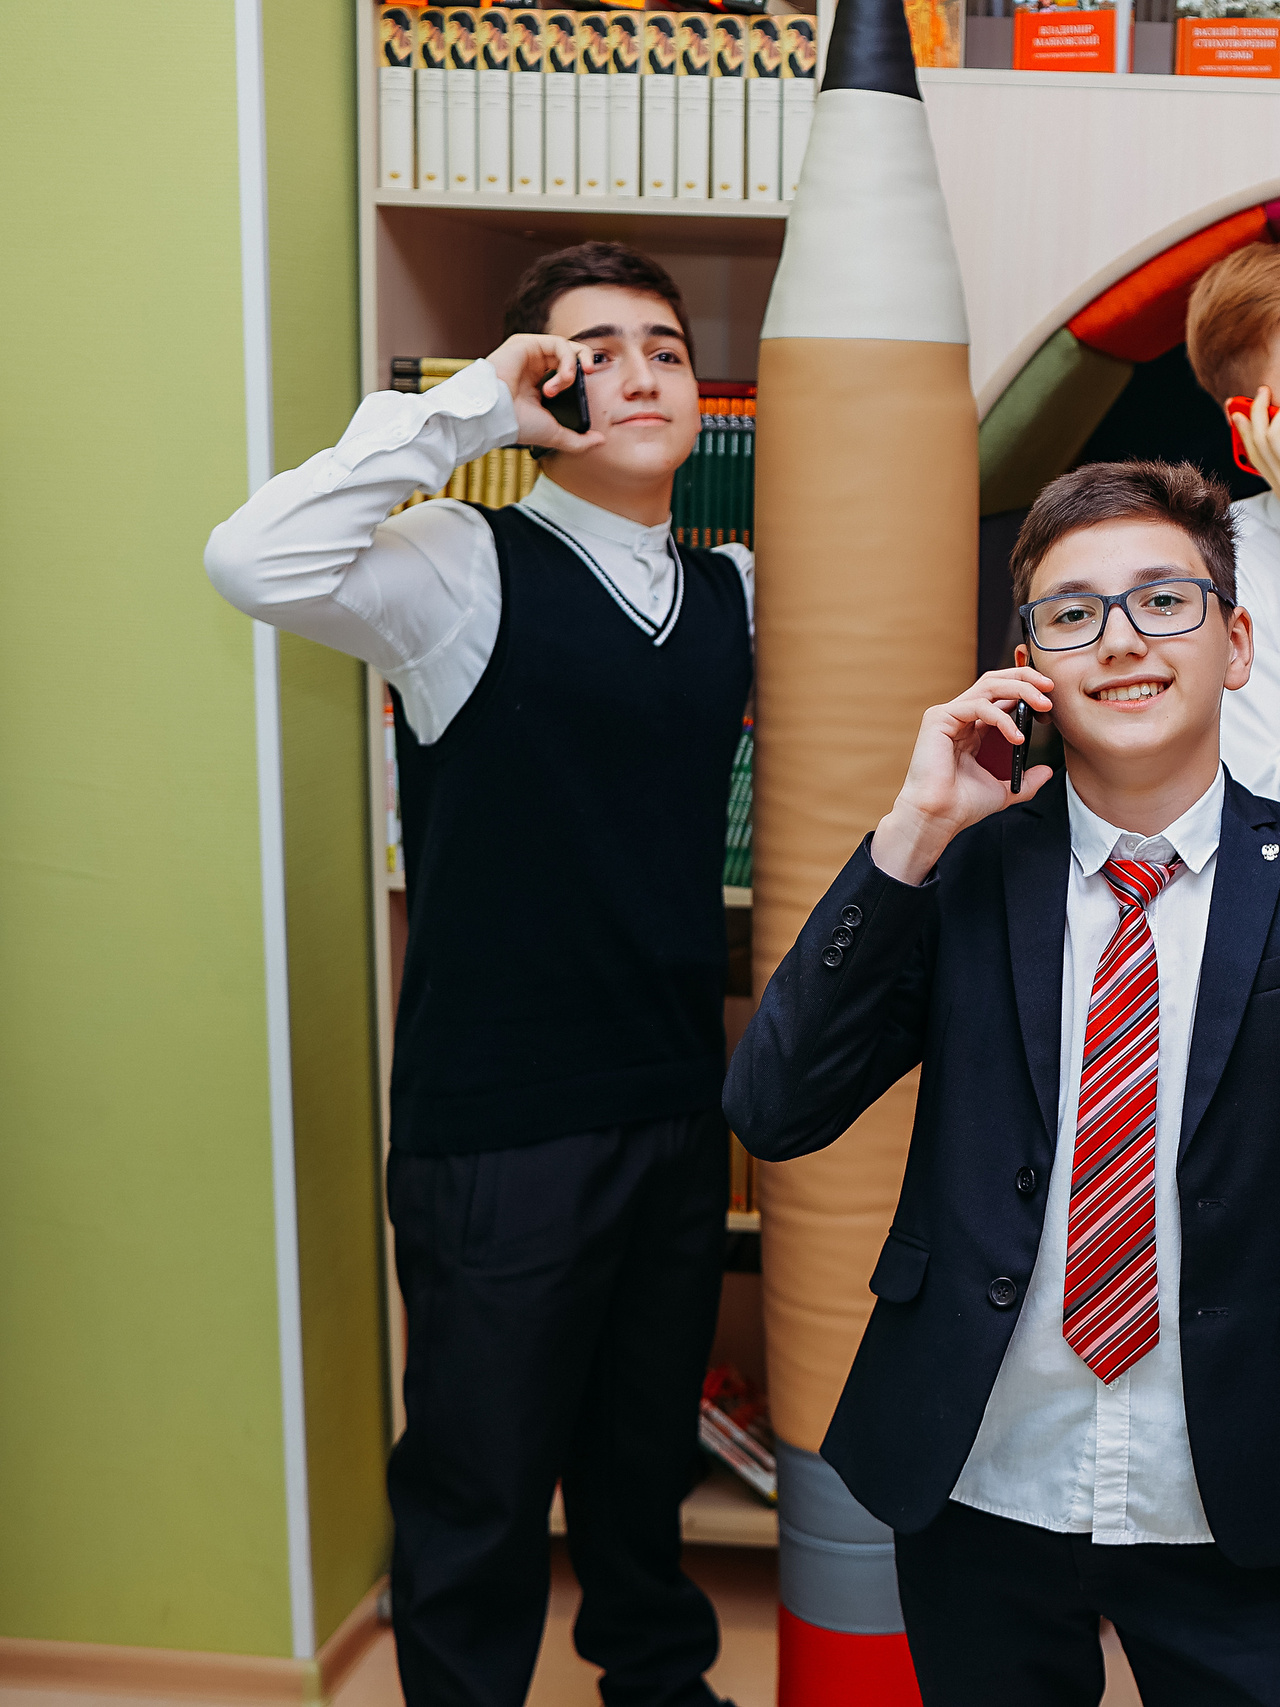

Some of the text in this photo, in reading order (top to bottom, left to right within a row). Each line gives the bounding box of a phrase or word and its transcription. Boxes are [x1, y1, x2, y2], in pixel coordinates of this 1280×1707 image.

[1039, 24, 1095, 35] ВЛАДИМИР
[1192, 26, 1239, 37] ВАСИЛИЙ
[1033, 34, 1100, 47] МАЯКОВСКИЙ
[1193, 39, 1277, 49] СТИХОТВОРЕНИЯ
[1215, 50, 1254, 60] ПОЭМЫ
